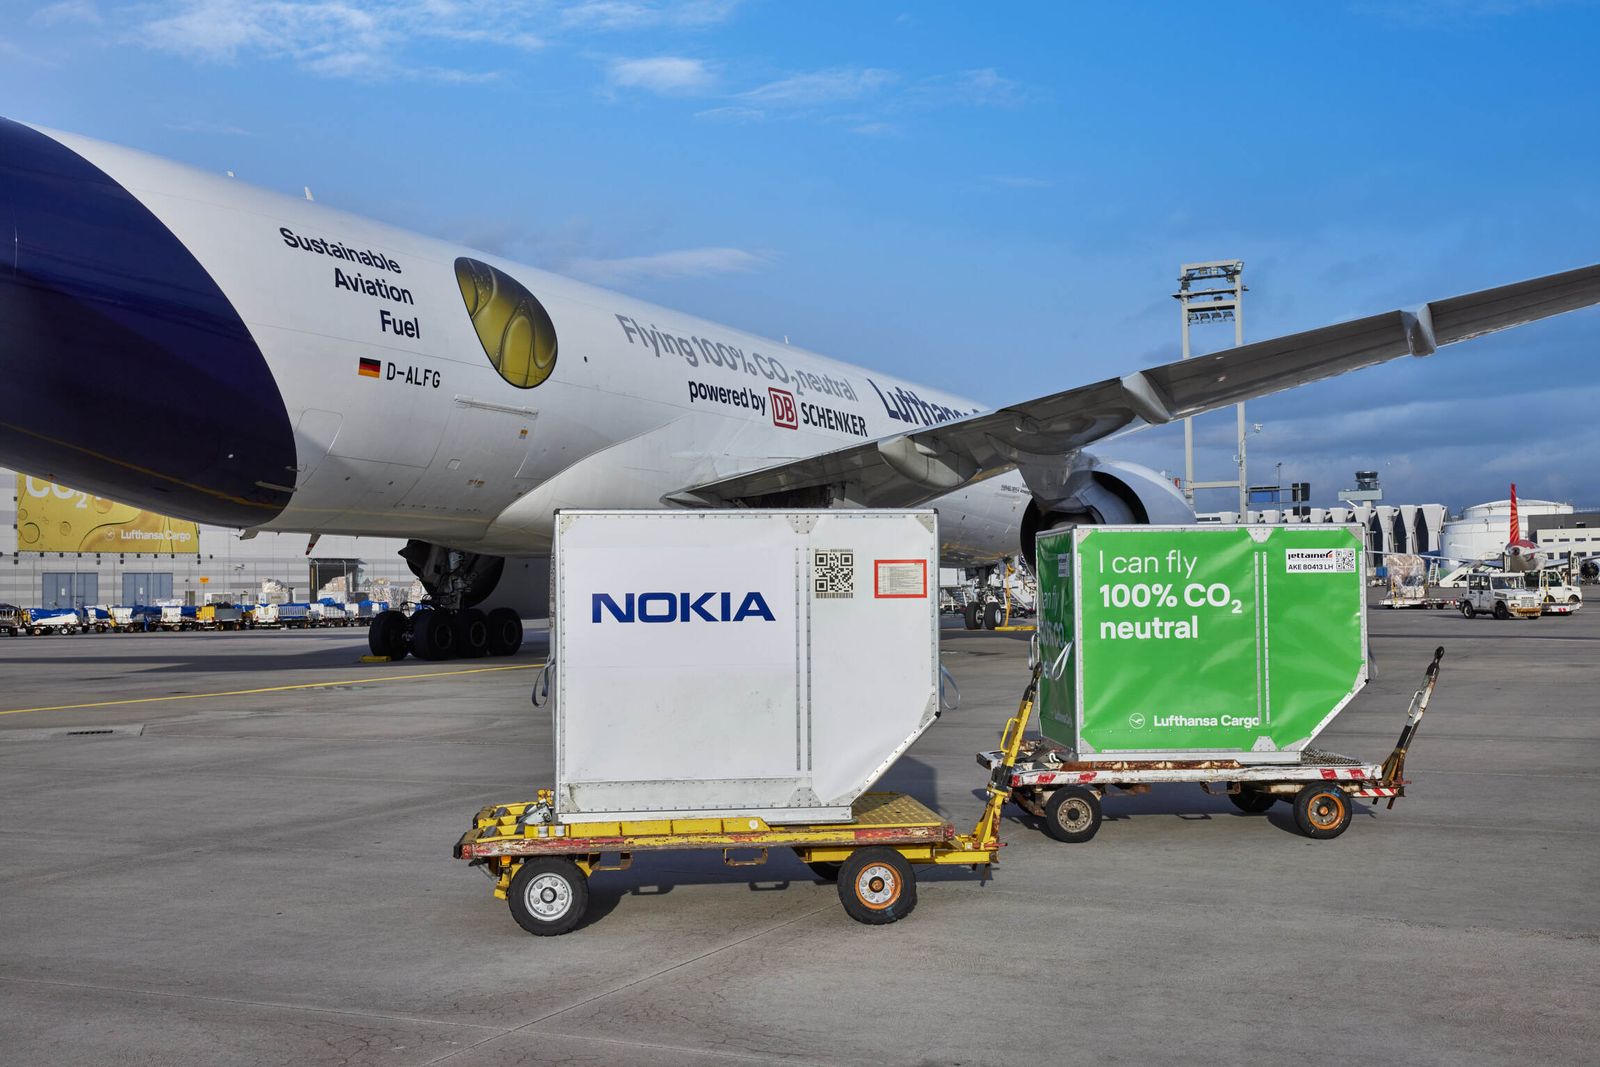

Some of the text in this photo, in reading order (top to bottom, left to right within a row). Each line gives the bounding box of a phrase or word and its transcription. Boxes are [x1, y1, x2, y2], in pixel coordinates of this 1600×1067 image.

[279, 227, 402, 274] Sustainable
[334, 267, 414, 305] Aviation
[380, 310, 421, 339] Fuel
[615, 313, 699, 367] Flying
[691, 336, 758, 376] 100%
[795, 369, 859, 402] neutral
[386, 362, 441, 388] D-ALFG
[688, 380, 868, 437] powered by DB SCHENKER
[866, 378, 969, 426] Lufthan
[121, 530, 191, 542] Lufthansa Cargo
[1100, 549, 1198, 579] I can fly
[1287, 550, 1333, 560] jettainer
[592, 592, 776, 623] NOKIA
[1099, 583, 1178, 608] 100%
[1100, 615, 1198, 640] neutral
[1153, 715, 1260, 729] Lufthansa Cargo
